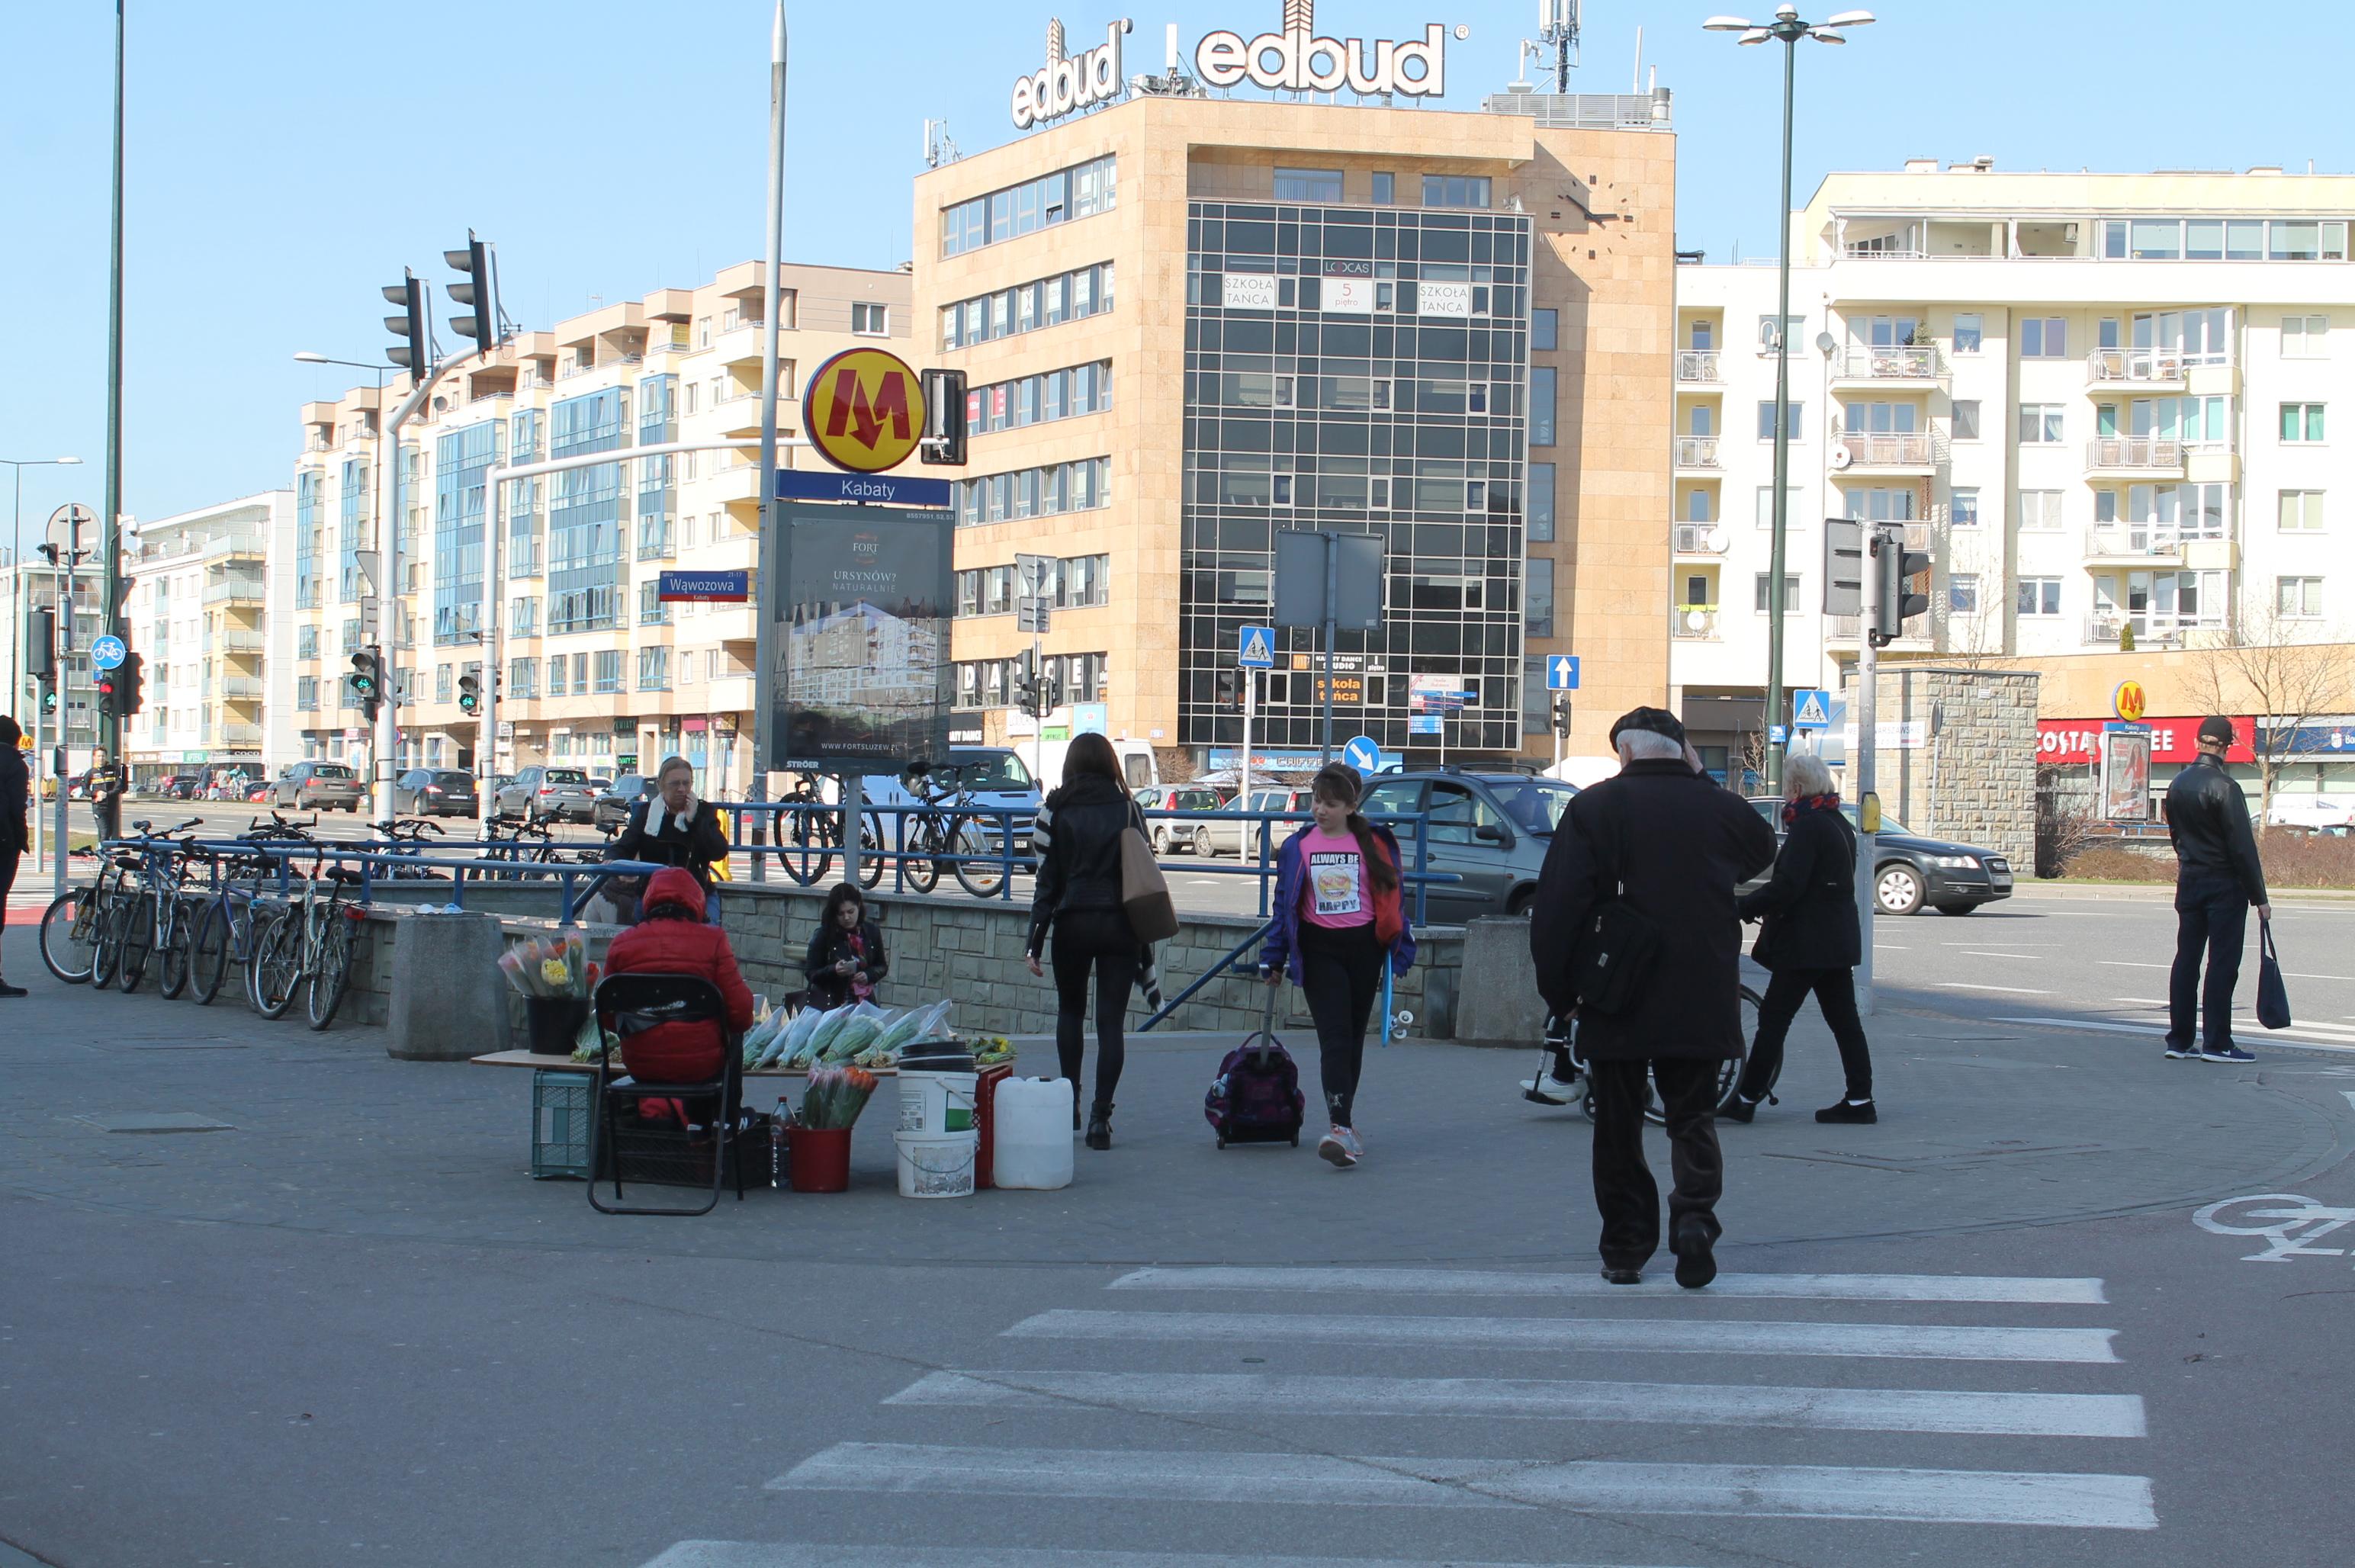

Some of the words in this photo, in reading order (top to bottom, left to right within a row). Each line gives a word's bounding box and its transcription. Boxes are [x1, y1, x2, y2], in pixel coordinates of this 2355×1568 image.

[1196, 0, 1444, 98] edbud
[1011, 16, 1122, 129] edbud
[1225, 278, 1274, 290] SZKOŁA
[1342, 283, 1351, 297] 5
[1420, 284, 1468, 298] SZKOŁA
[1226, 291, 1270, 306] TAŃCA
[1335, 297, 1359, 307] piętro
[1422, 299, 1464, 313] TAŃCA
[842, 480, 895, 500] Kabaty
[853, 542, 879, 554] FORT
[834, 570, 896, 582] URSYNÓW?
[670, 579, 734, 593] Wąwozowa
[833, 583, 896, 593] NATURALNIE
[1311, 854, 1346, 864] ALWAYS
[1348, 854, 1359, 864] BE
[1319, 900, 1356, 911] HAPPY
